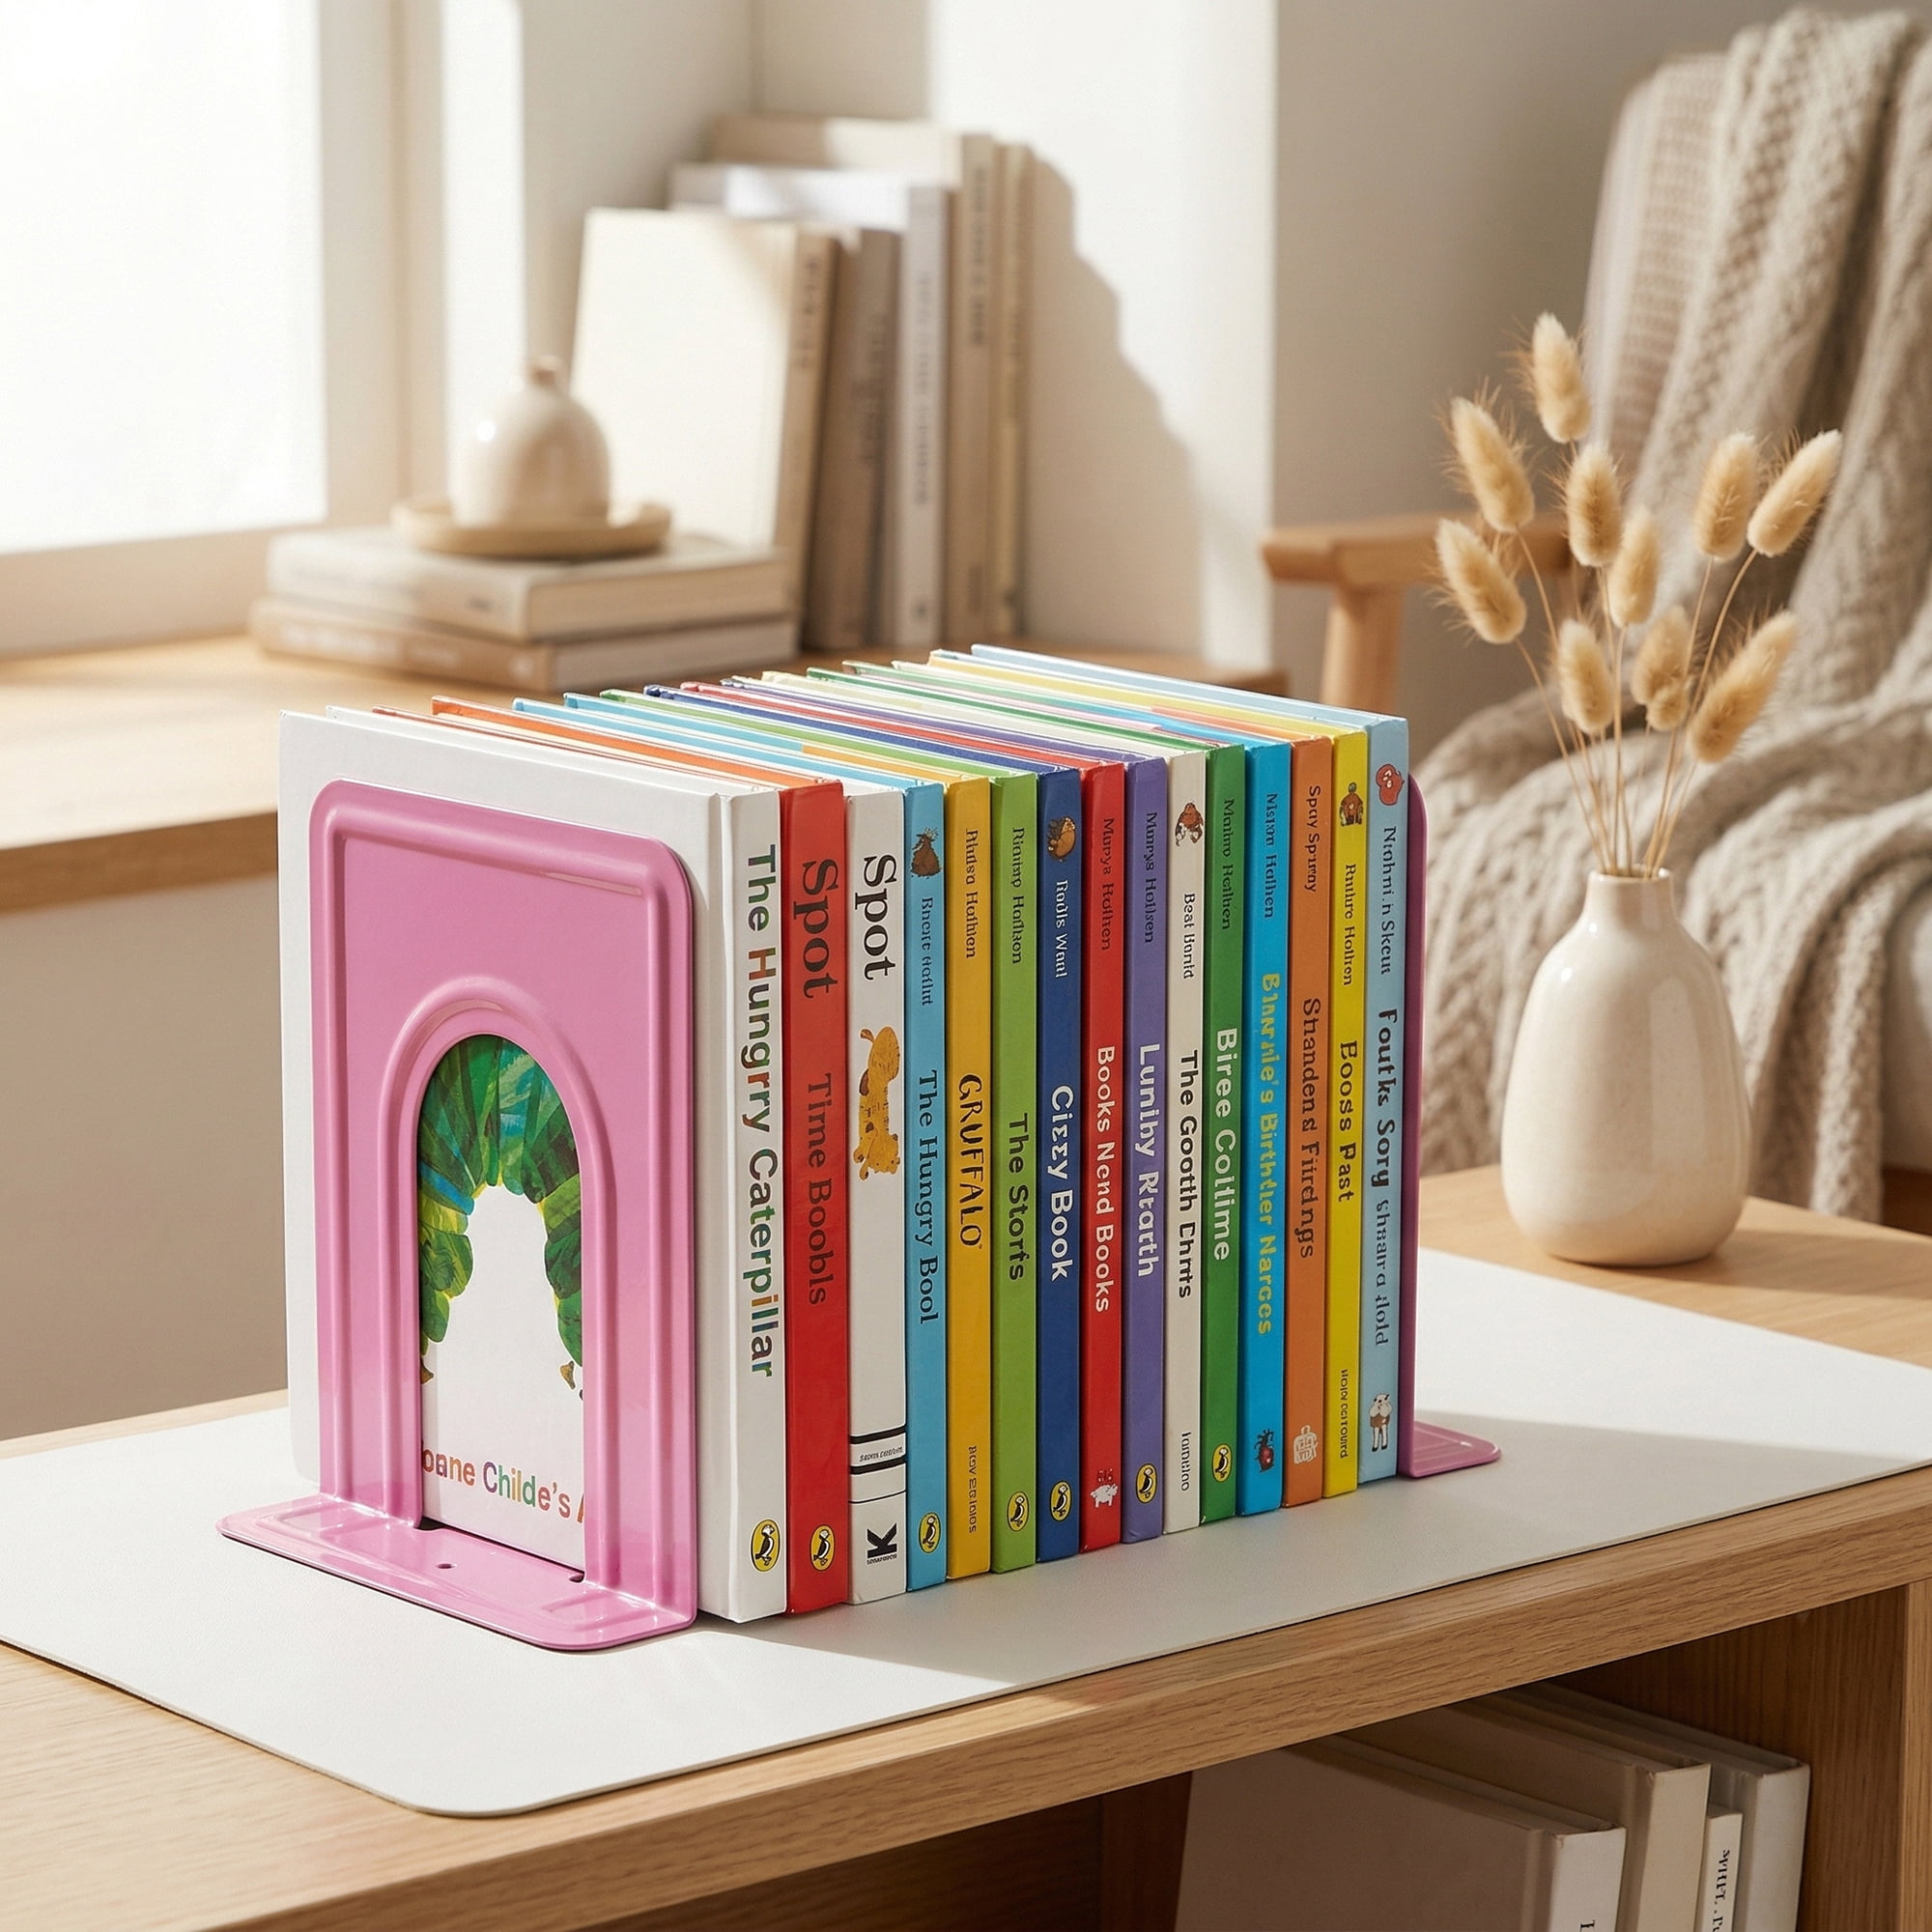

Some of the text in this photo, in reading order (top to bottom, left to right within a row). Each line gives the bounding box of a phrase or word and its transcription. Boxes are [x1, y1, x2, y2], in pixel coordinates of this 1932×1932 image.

[748, 843, 777, 932] The
[794, 858, 839, 1000] Spot
[855, 853, 898, 981] Spot
[918, 1068, 939, 1128] The
[1095, 1044, 1116, 1133] Books
[1179, 1049, 1199, 1106] The
[957, 1073, 984, 1248] GRUFFALO
[1008, 1112, 1028, 1174] The
[915, 1135, 939, 1247] Hungry
[1050, 1189, 1073, 1282] Book
[742, 1148, 779, 1378] Caterpillar
[1094, 1224, 1115, 1313] Books
[482, 1461, 572, 1519] Childe's
